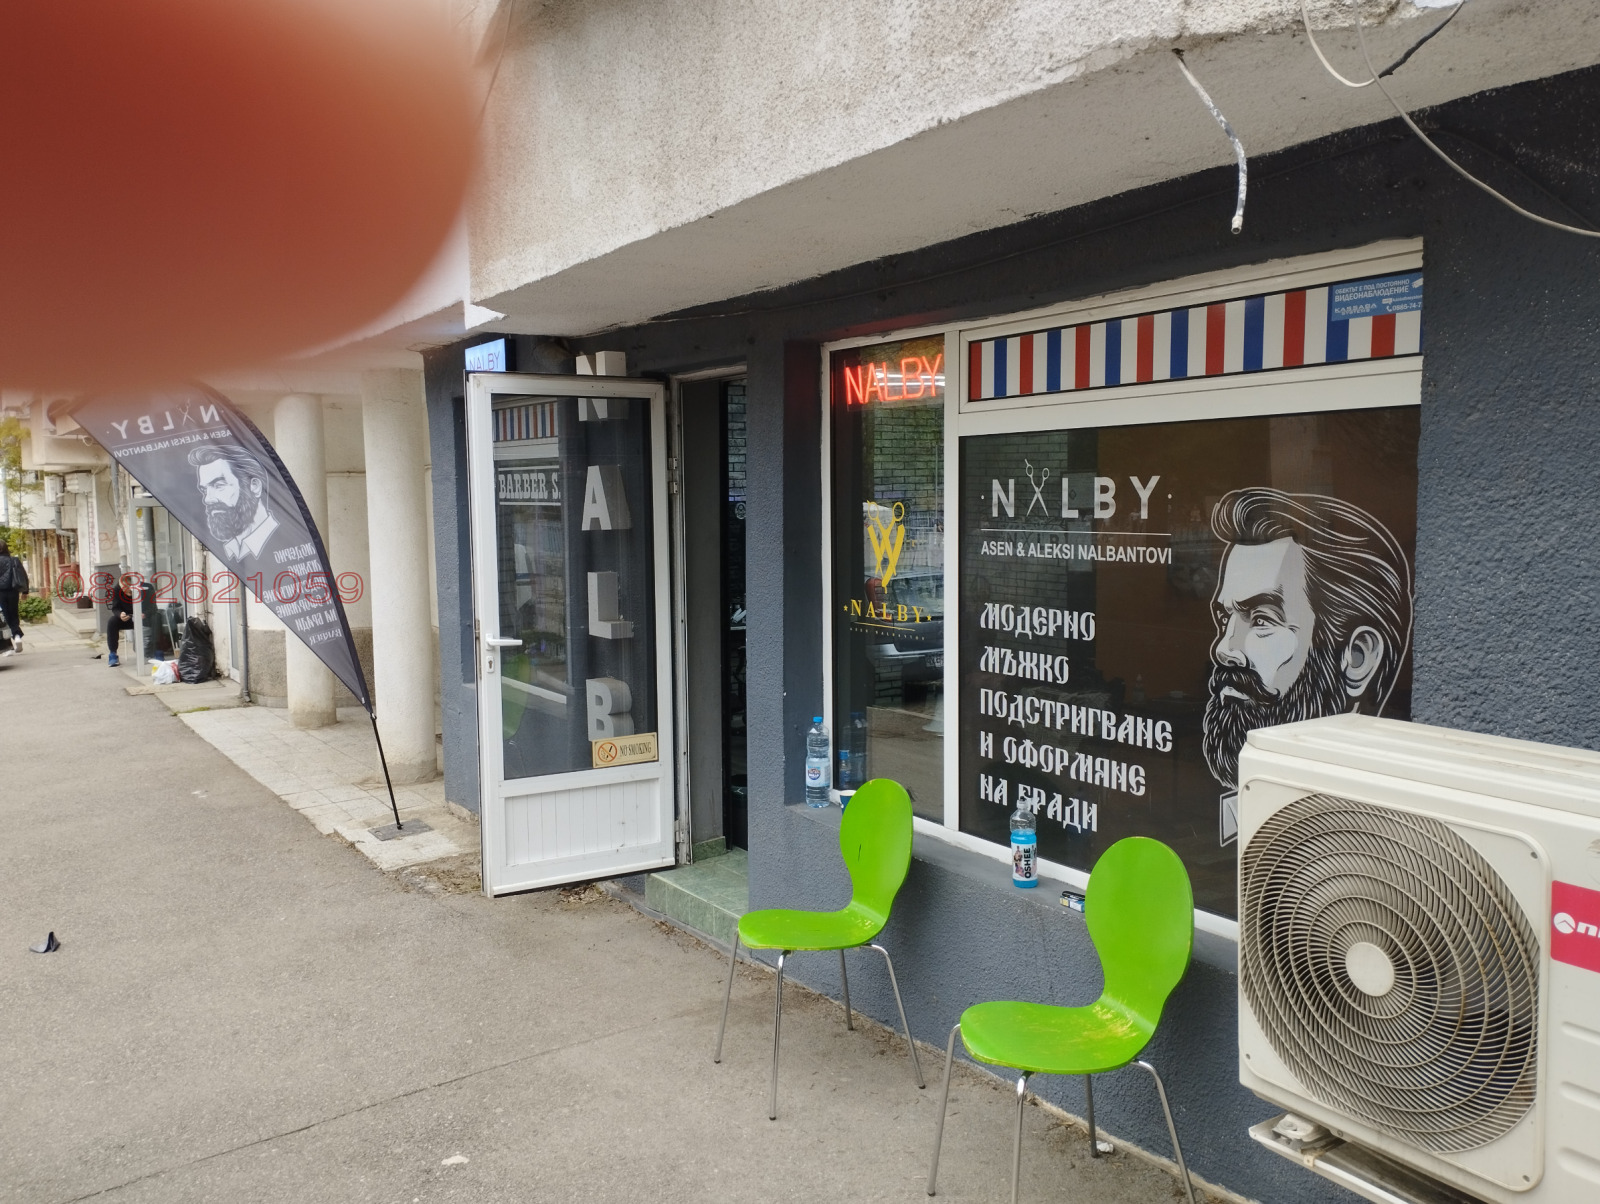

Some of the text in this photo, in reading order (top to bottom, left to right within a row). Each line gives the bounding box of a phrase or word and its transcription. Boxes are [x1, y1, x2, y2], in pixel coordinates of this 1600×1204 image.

[1334, 286, 1358, 295] ОБЕКТЪТ
[1376, 279, 1410, 289] ПОСТОЯННО
[1334, 285, 1409, 302] ВИДЕОНАБЛЮДЕНИЕ
[844, 353, 943, 405] NALBY
[498, 472, 548, 499] BARBER
[981, 541, 1172, 565] ASEN & ALEKSI NALBANTOVI
[850, 599, 924, 624] NALBY
[980, 602, 1096, 641] МОДЕРНО
[979, 645, 1070, 685] МЪЖКО
[980, 688, 1173, 753] ПОДСТРИГВАНЕ
[980, 730, 1146, 797] И ОФОРМЯНЕ
[980, 773, 1008, 806] НА
[1023, 848, 1032, 879] OSHEE
